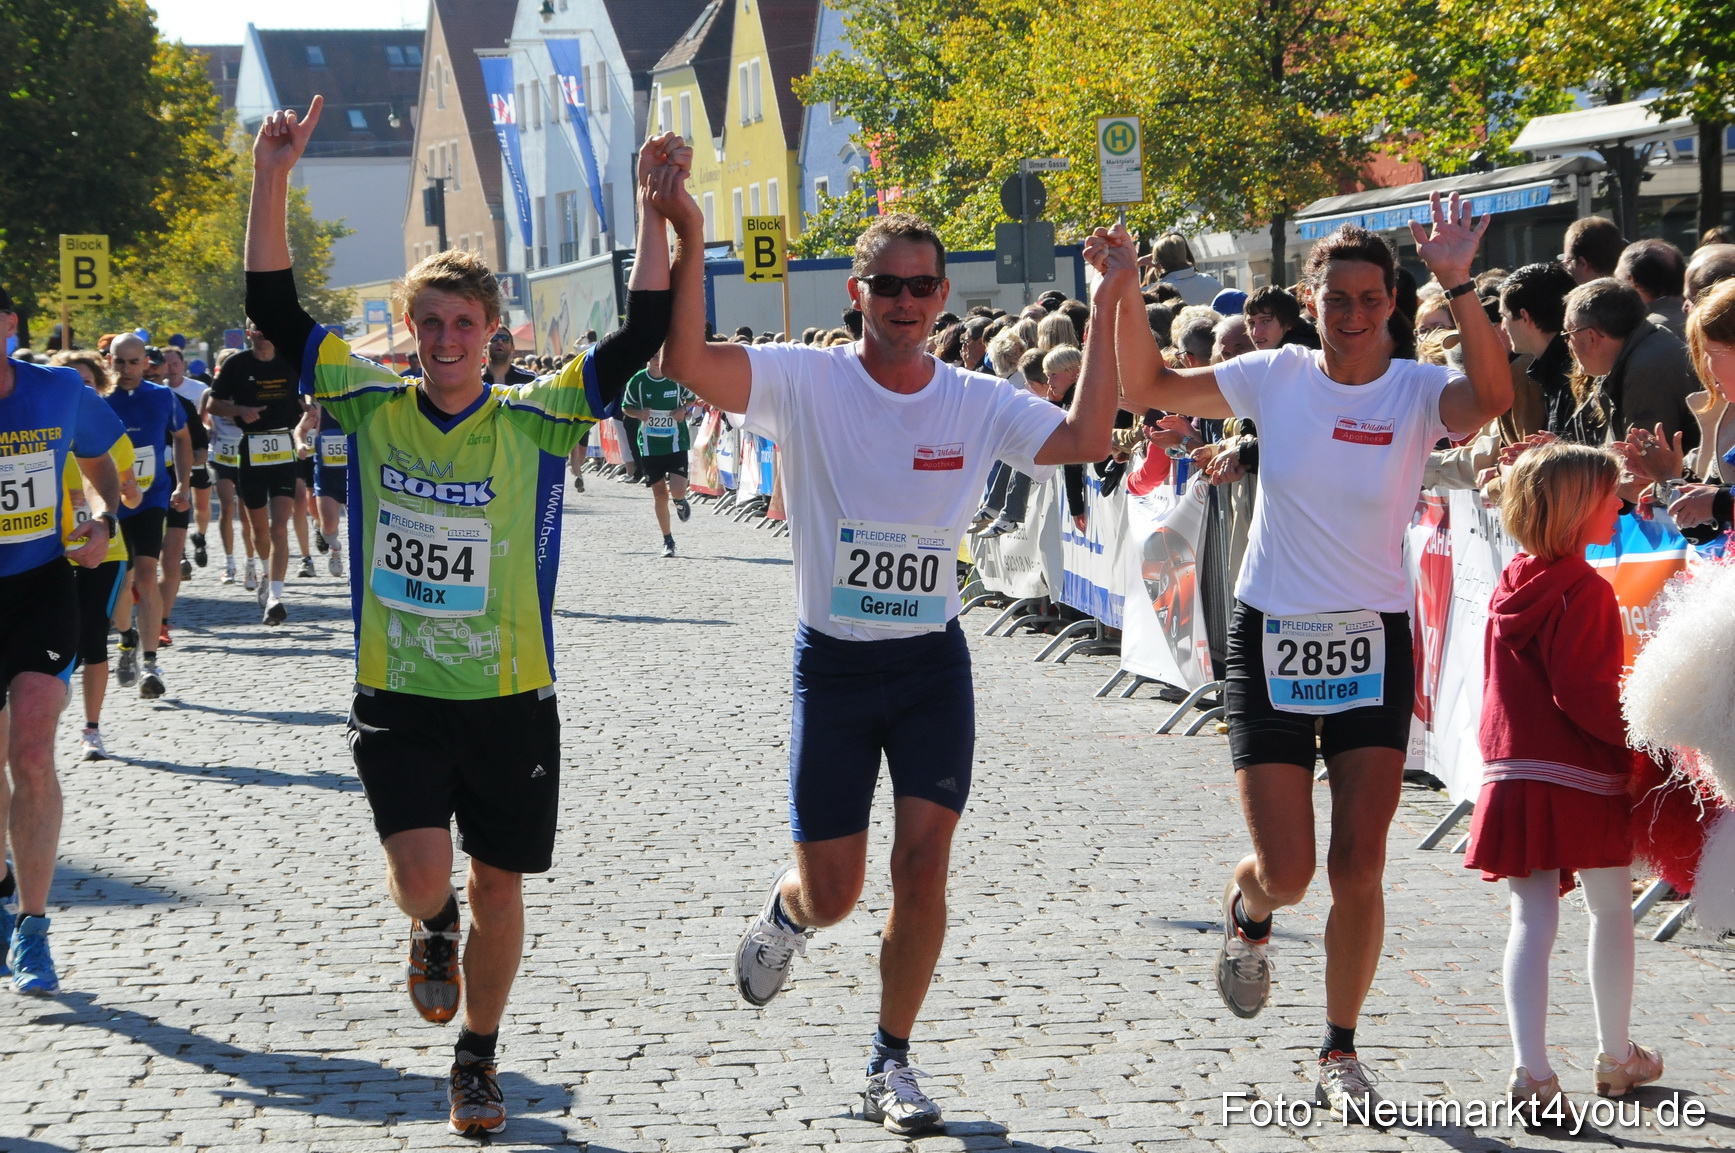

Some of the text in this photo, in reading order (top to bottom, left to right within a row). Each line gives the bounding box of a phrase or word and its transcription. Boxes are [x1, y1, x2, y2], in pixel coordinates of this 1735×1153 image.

[1110, 129, 1128, 149] H
[1028, 161, 1047, 169] Ulmer
[747, 218, 781, 231] Block
[66, 238, 103, 251] Block
[754, 236, 777, 268] B
[74, 256, 97, 289] B
[648, 416, 673, 428] 3220
[261, 438, 279, 453] 30
[1342, 432, 1384, 443] Apotheke
[261, 453, 281, 461] Peter
[387, 442, 454, 478] TEAM
[381, 464, 496, 506] BOCK
[2, 512, 49, 532] annes
[391, 513, 435, 534] PFLEIDERER
[855, 529, 907, 543] PFLEIDERER
[855, 540, 907, 549] AKTIENGESELLSCHAFT
[385, 532, 475, 583] 3354
[847, 548, 939, 593] 2860
[406, 579, 447, 605] Max
[860, 595, 919, 618] Gerald
[1281, 620, 1334, 632] PFLEIDERER
[1277, 637, 1371, 676] 2859
[1290, 680, 1359, 700] Andrea
